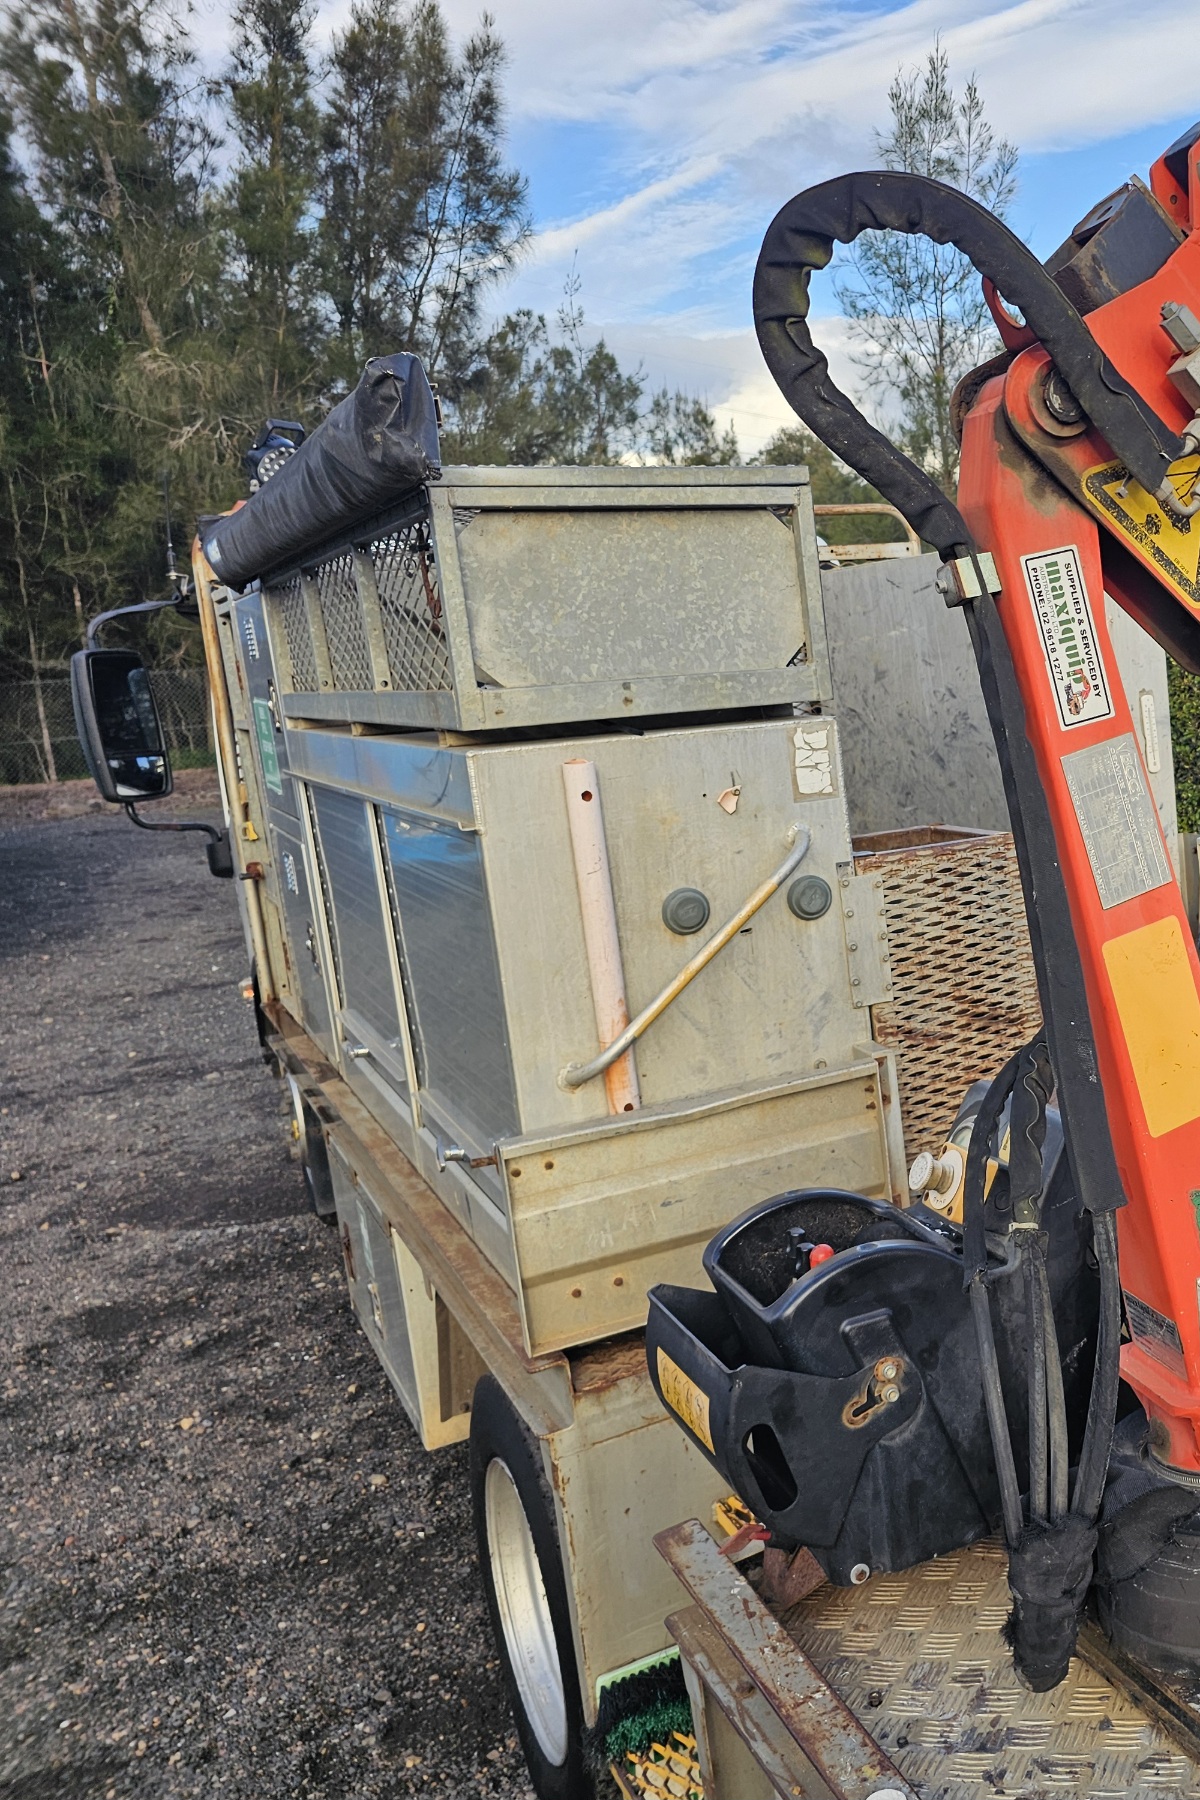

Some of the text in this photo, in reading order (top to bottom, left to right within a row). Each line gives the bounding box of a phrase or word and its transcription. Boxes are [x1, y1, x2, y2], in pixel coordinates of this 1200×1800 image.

[1031, 567, 1063, 682] PHONE: 02 9618 1277
[1038, 565, 1052, 604] AUSTRALIA
[1045, 560, 1085, 685] maxiquip
[1064, 562, 1101, 698] SUPPLIED & SERVICED BY
[1076, 809, 1089, 835] CRANE
